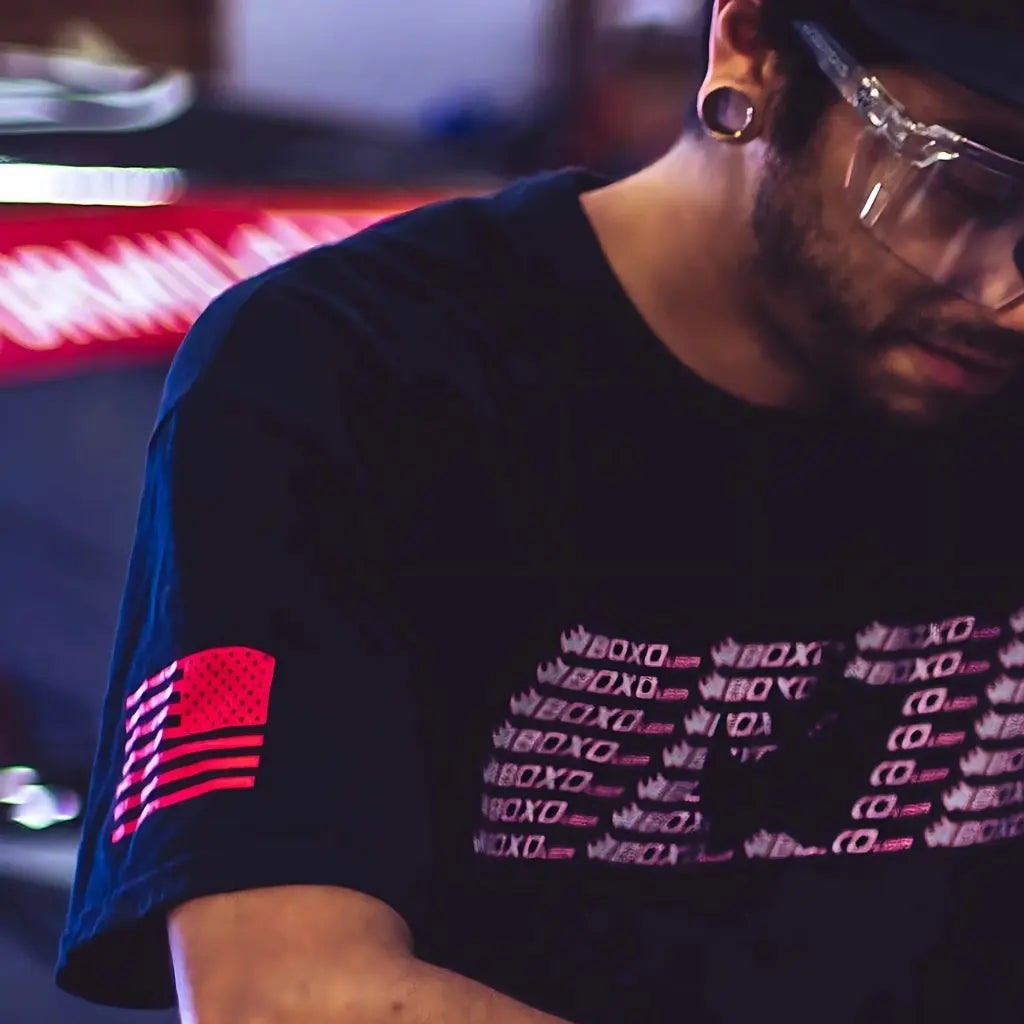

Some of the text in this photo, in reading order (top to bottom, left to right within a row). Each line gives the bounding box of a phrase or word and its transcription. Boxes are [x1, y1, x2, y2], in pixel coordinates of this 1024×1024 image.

[585, 634, 669, 668] BOXO
[560, 666, 658, 700] BOXO
[534, 696, 644, 732] BOXO
[512, 728, 619, 763] BOXO
[498, 761, 595, 793] BOXO
